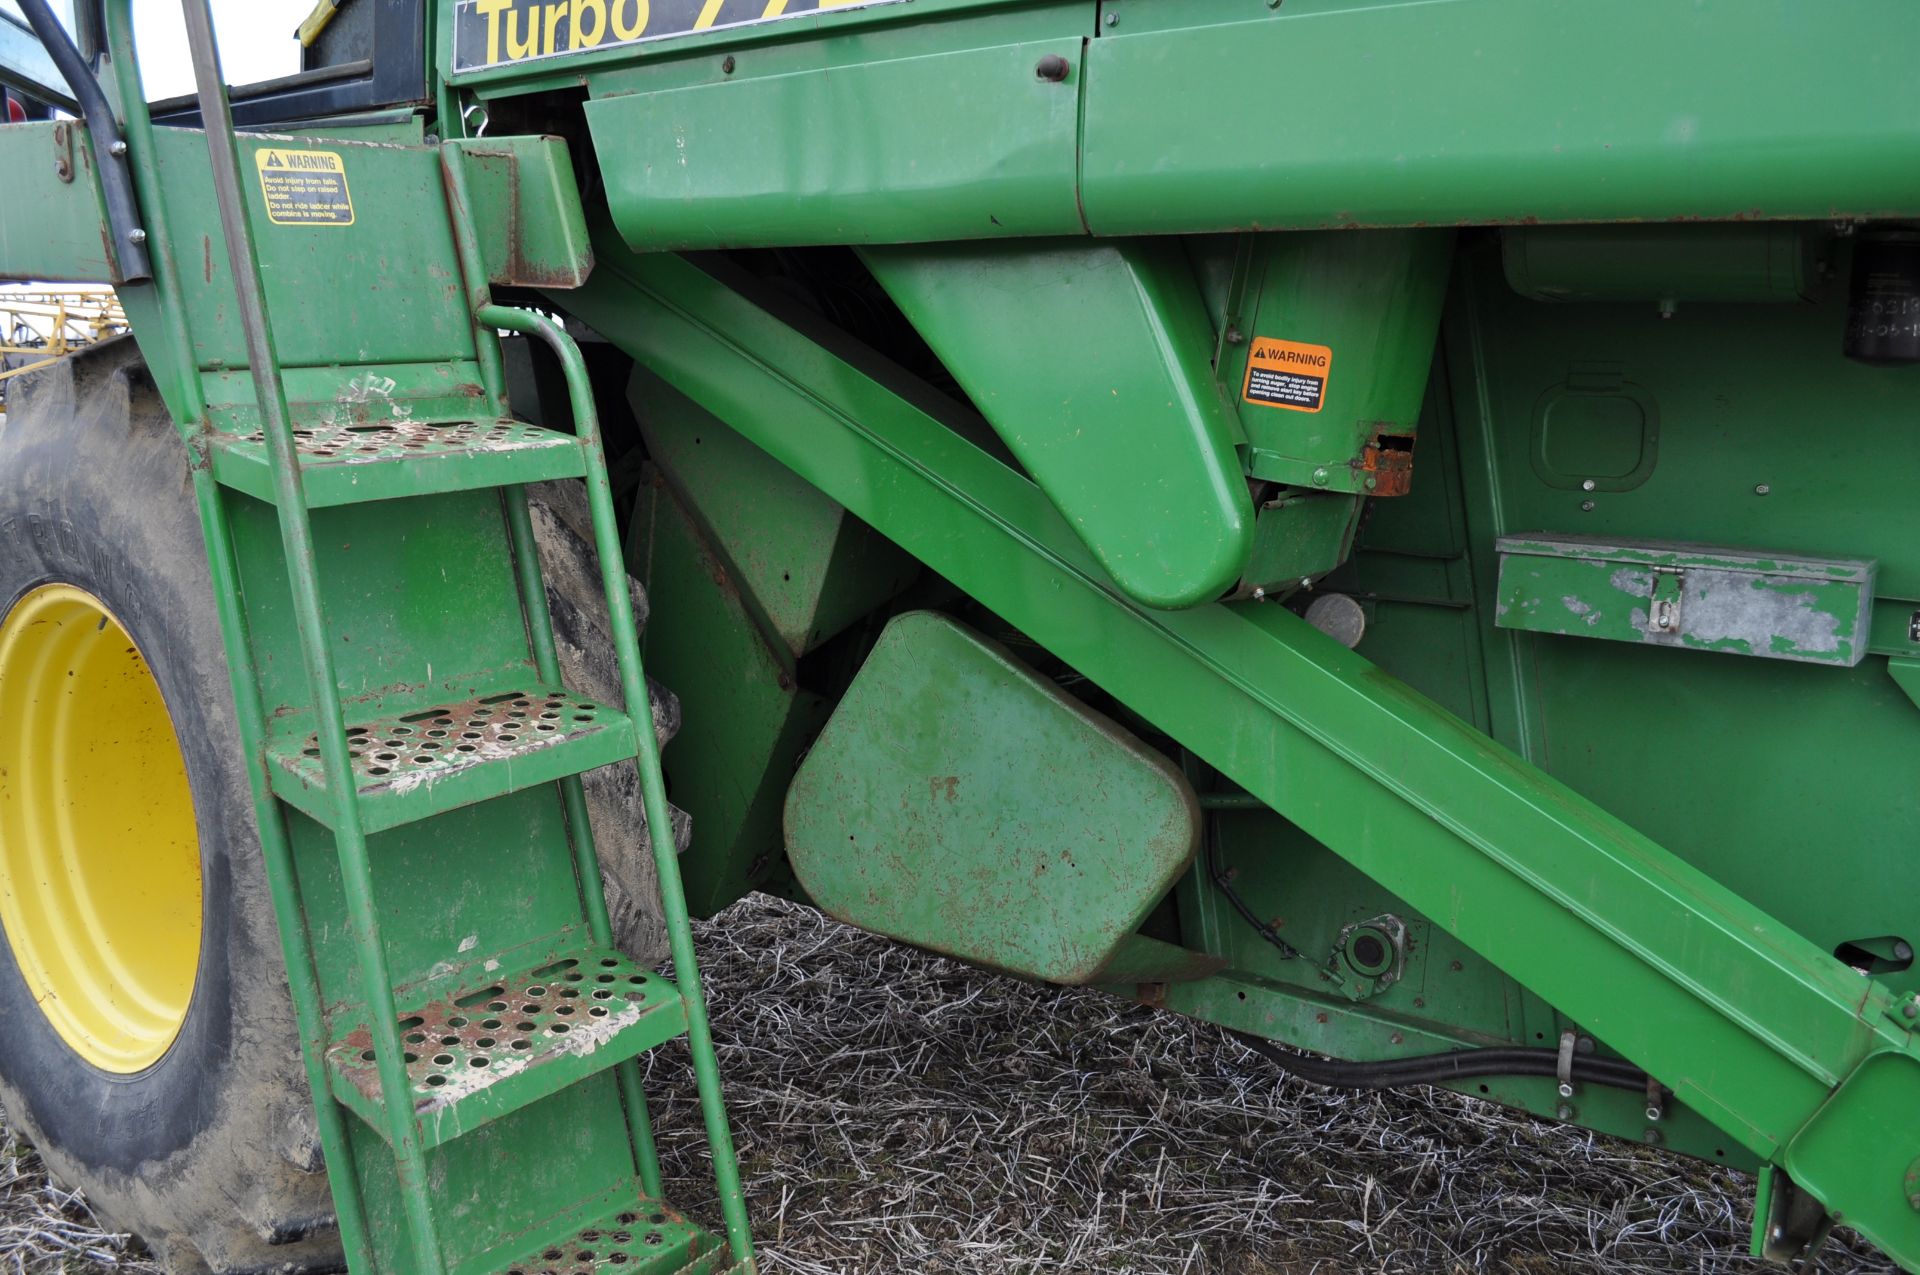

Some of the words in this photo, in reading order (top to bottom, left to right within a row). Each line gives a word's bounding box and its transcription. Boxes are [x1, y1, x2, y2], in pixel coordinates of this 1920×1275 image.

[477, 0, 649, 65] Turbo
[286, 154, 336, 169] WARNING
[264, 176, 284, 184] Avoid
[285, 177, 304, 185] injury
[291, 185, 305, 193] step
[311, 211, 337, 219] moving.
[1268, 348, 1326, 367] WARNING
[1275, 374, 1290, 382] bodily
[1292, 376, 1306, 384] injury
